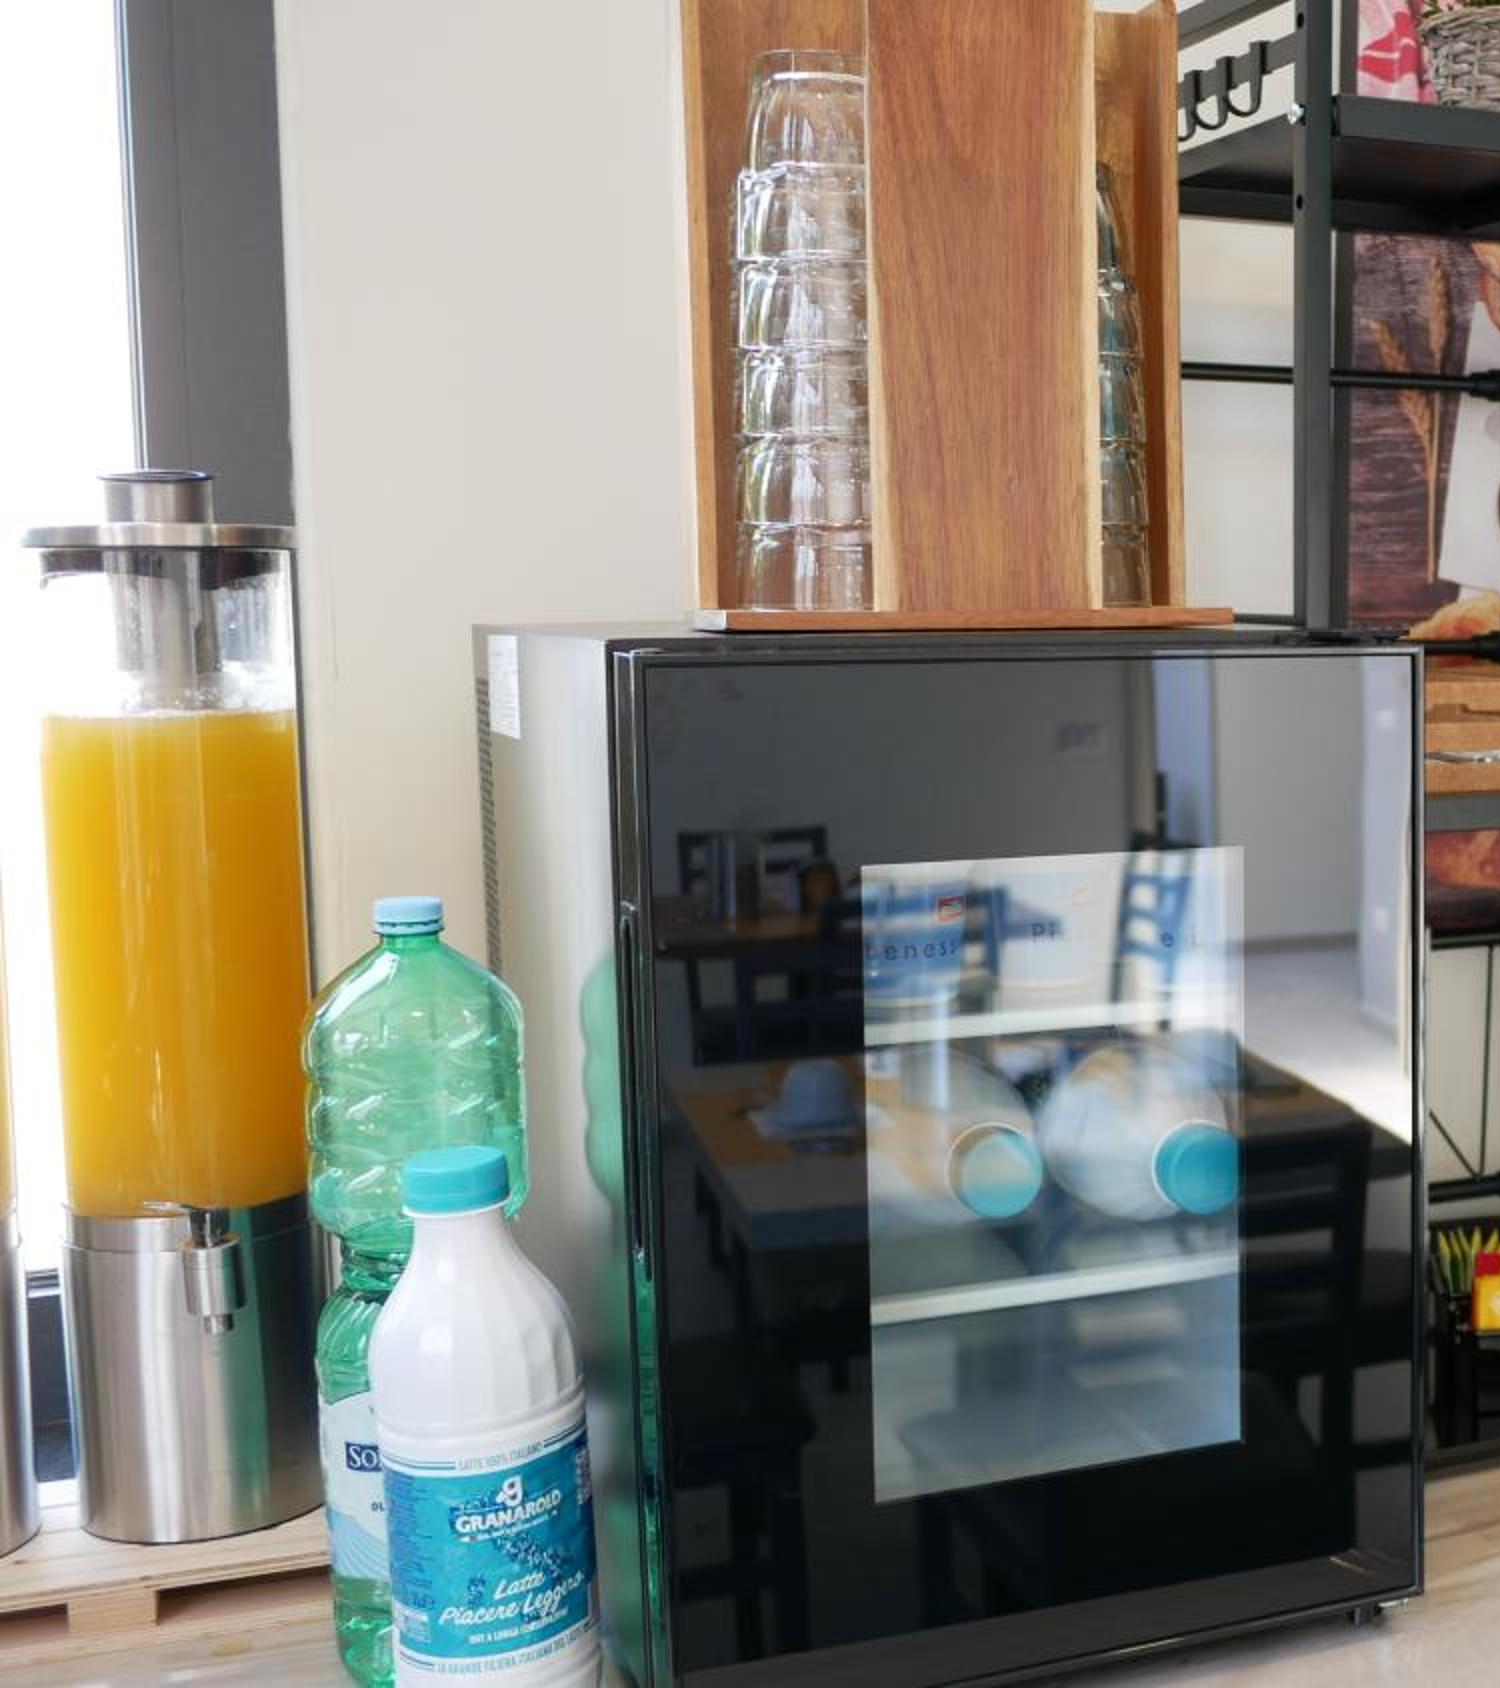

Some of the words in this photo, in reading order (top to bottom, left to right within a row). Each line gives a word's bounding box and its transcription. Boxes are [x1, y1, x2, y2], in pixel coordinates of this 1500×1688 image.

[455, 1489, 562, 1533] GRANAROLO
[438, 1600, 520, 1625] Piacere
[522, 1570, 585, 1616] Leggero
[494, 1571, 545, 1600] Latte
